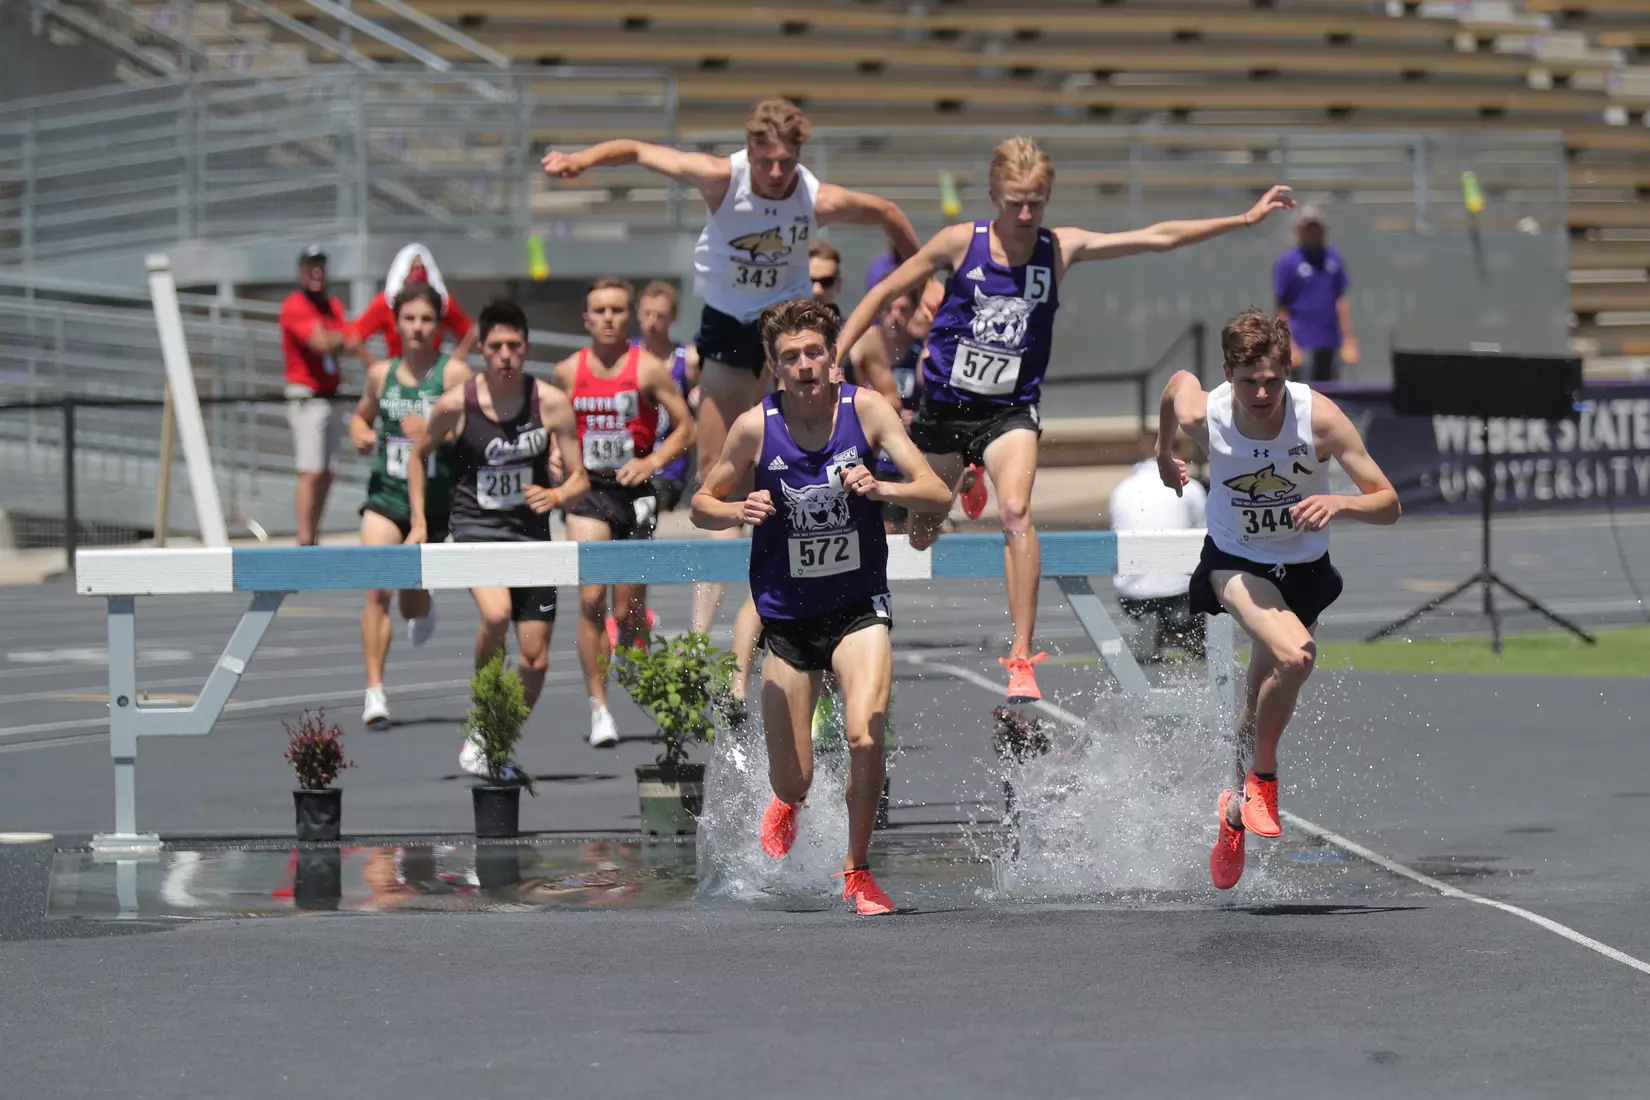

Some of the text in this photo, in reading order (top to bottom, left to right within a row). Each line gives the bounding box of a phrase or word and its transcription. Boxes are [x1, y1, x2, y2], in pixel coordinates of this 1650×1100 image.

[736, 265, 778, 288] 343
[1031, 269, 1046, 299] 5
[963, 350, 1010, 384] 577
[1432, 398, 1650, 455] WEBER STATE
[486, 473, 522, 496] 281
[1439, 455, 1650, 503] UNIVERSITY
[1243, 508, 1293, 534] 344
[800, 536, 850, 567] 572
